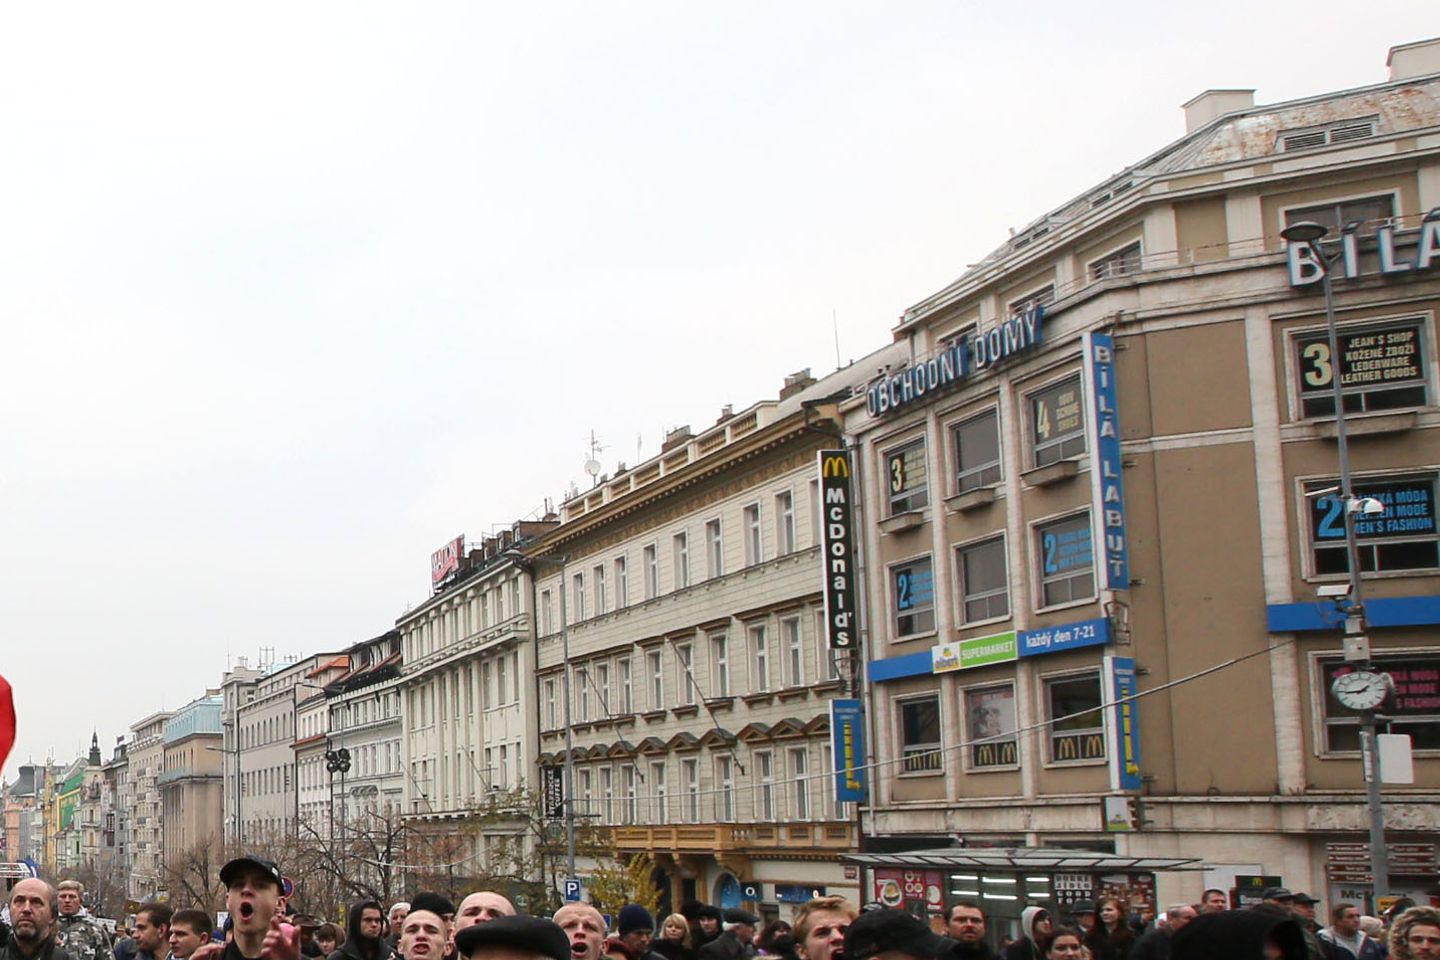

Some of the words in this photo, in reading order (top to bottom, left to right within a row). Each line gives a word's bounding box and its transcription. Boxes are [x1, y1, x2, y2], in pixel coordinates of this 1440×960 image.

[866, 341, 965, 418] OBCHODNÍ
[1303, 342, 1333, 387] 3
[1037, 401, 1051, 438] 4
[891, 458, 904, 493] 3
[1316, 494, 1345, 537] 2
[1044, 533, 1059, 574] 2
[898, 574, 909, 609] 2
[1054, 629, 1072, 643] den
[567, 882, 578, 896] P
